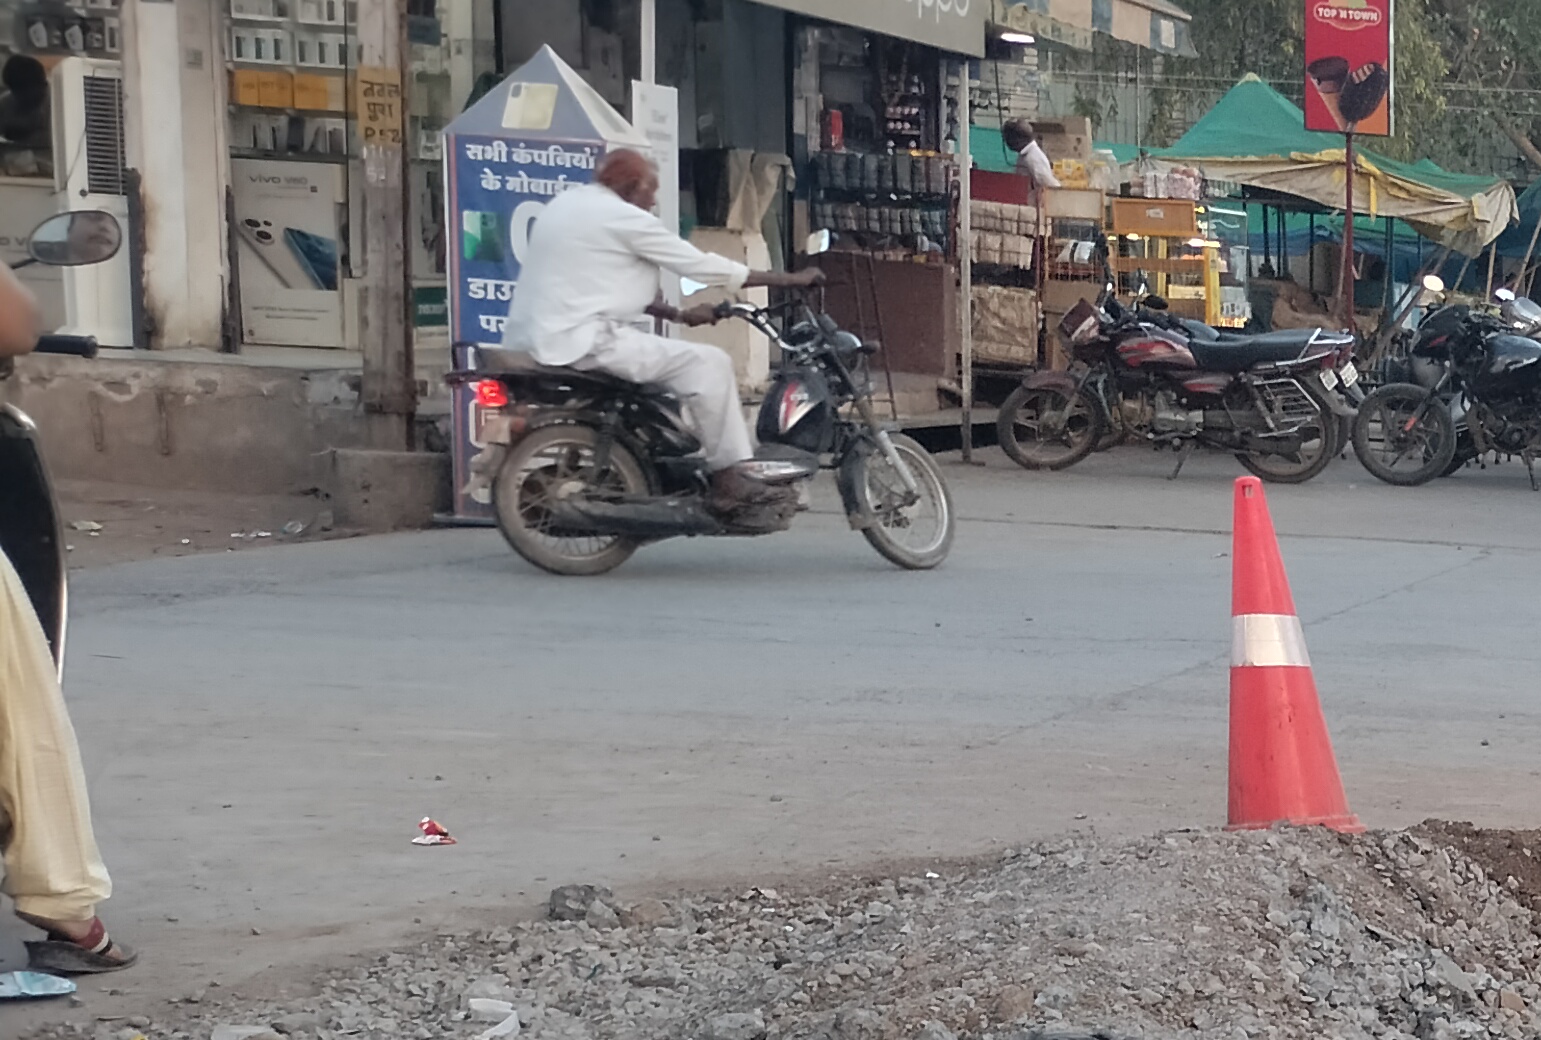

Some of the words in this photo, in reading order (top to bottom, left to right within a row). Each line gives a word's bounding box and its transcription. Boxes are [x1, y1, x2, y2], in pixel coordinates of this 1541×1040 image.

[905, 0, 969, 23] ppo
[1318, 7, 1337, 17] TOP
[1348, 10, 1378, 21] TOWN
[466, 141, 508, 163] सभी
[512, 142, 600, 170] कंपनियों
[249, 174, 281, 184] vivo
[481, 168, 503, 191] के
